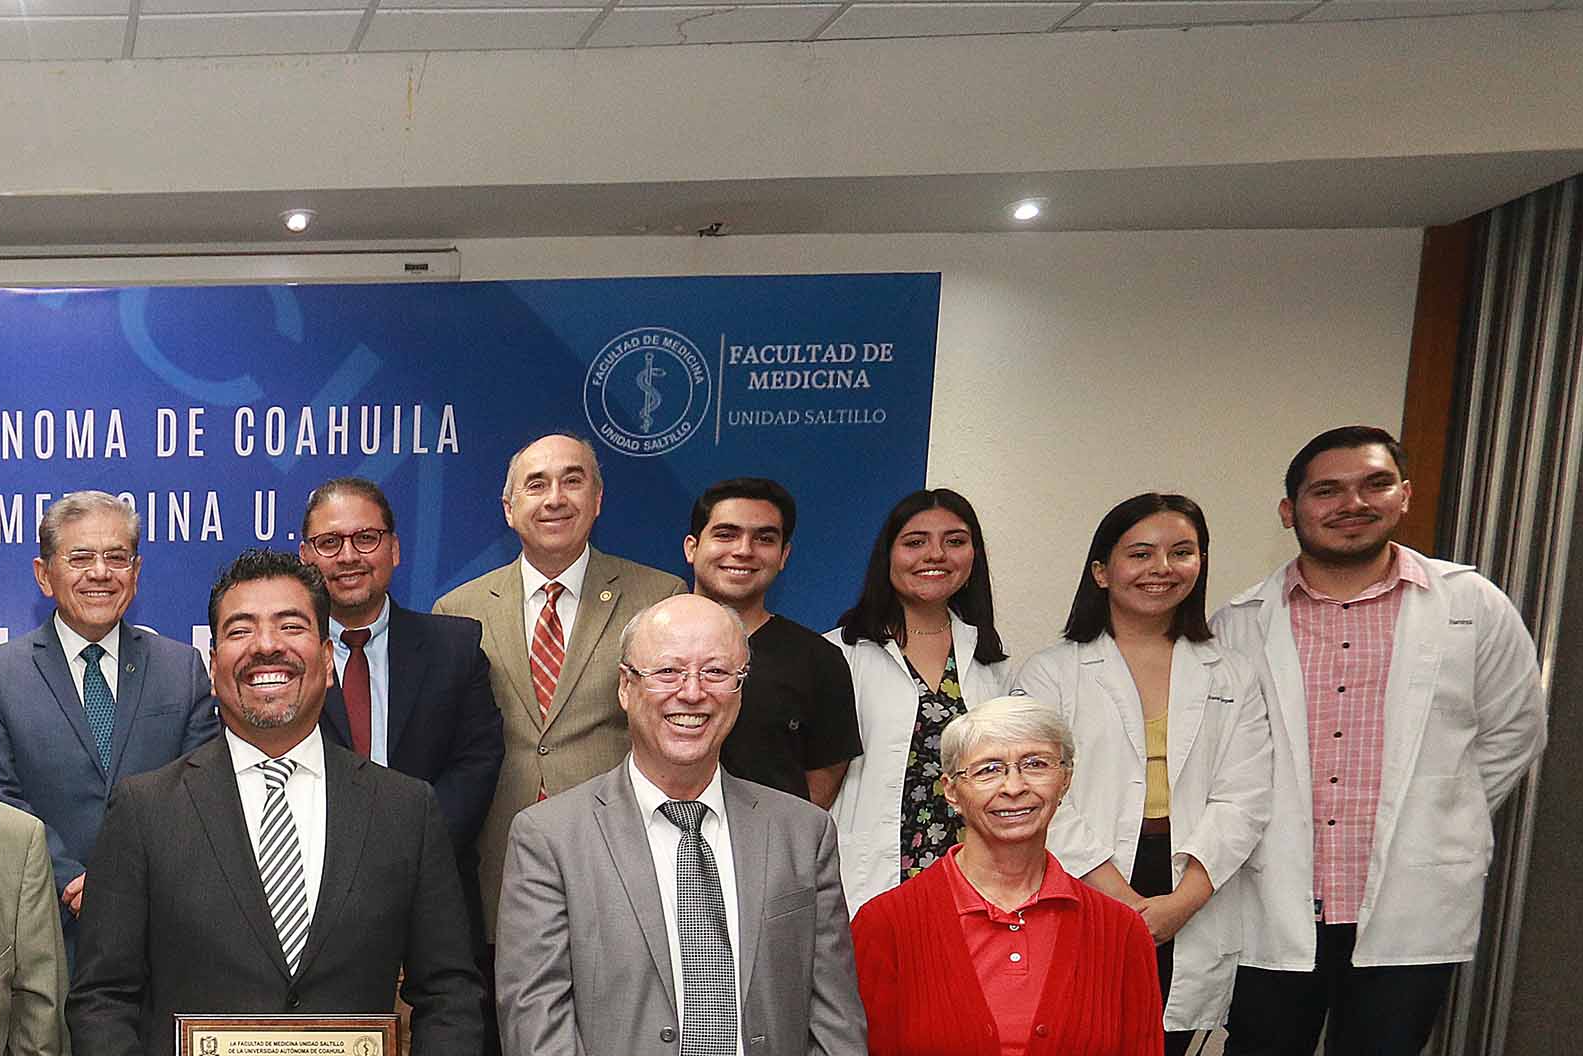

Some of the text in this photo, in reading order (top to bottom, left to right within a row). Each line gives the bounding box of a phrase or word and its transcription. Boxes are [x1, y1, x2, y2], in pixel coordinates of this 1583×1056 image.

[593, 335, 704, 386] FACULTAD DE MEDICINA
[728, 343, 894, 365] FACULTAD DE
[747, 369, 871, 390] MEDICINA
[728, 408, 887, 426] UNIDAD SALTILLO
[156, 407, 206, 458] DE
[234, 404, 460, 457] COAHUILA
[600, 421, 691, 451] UNIDAD SALTILLO
